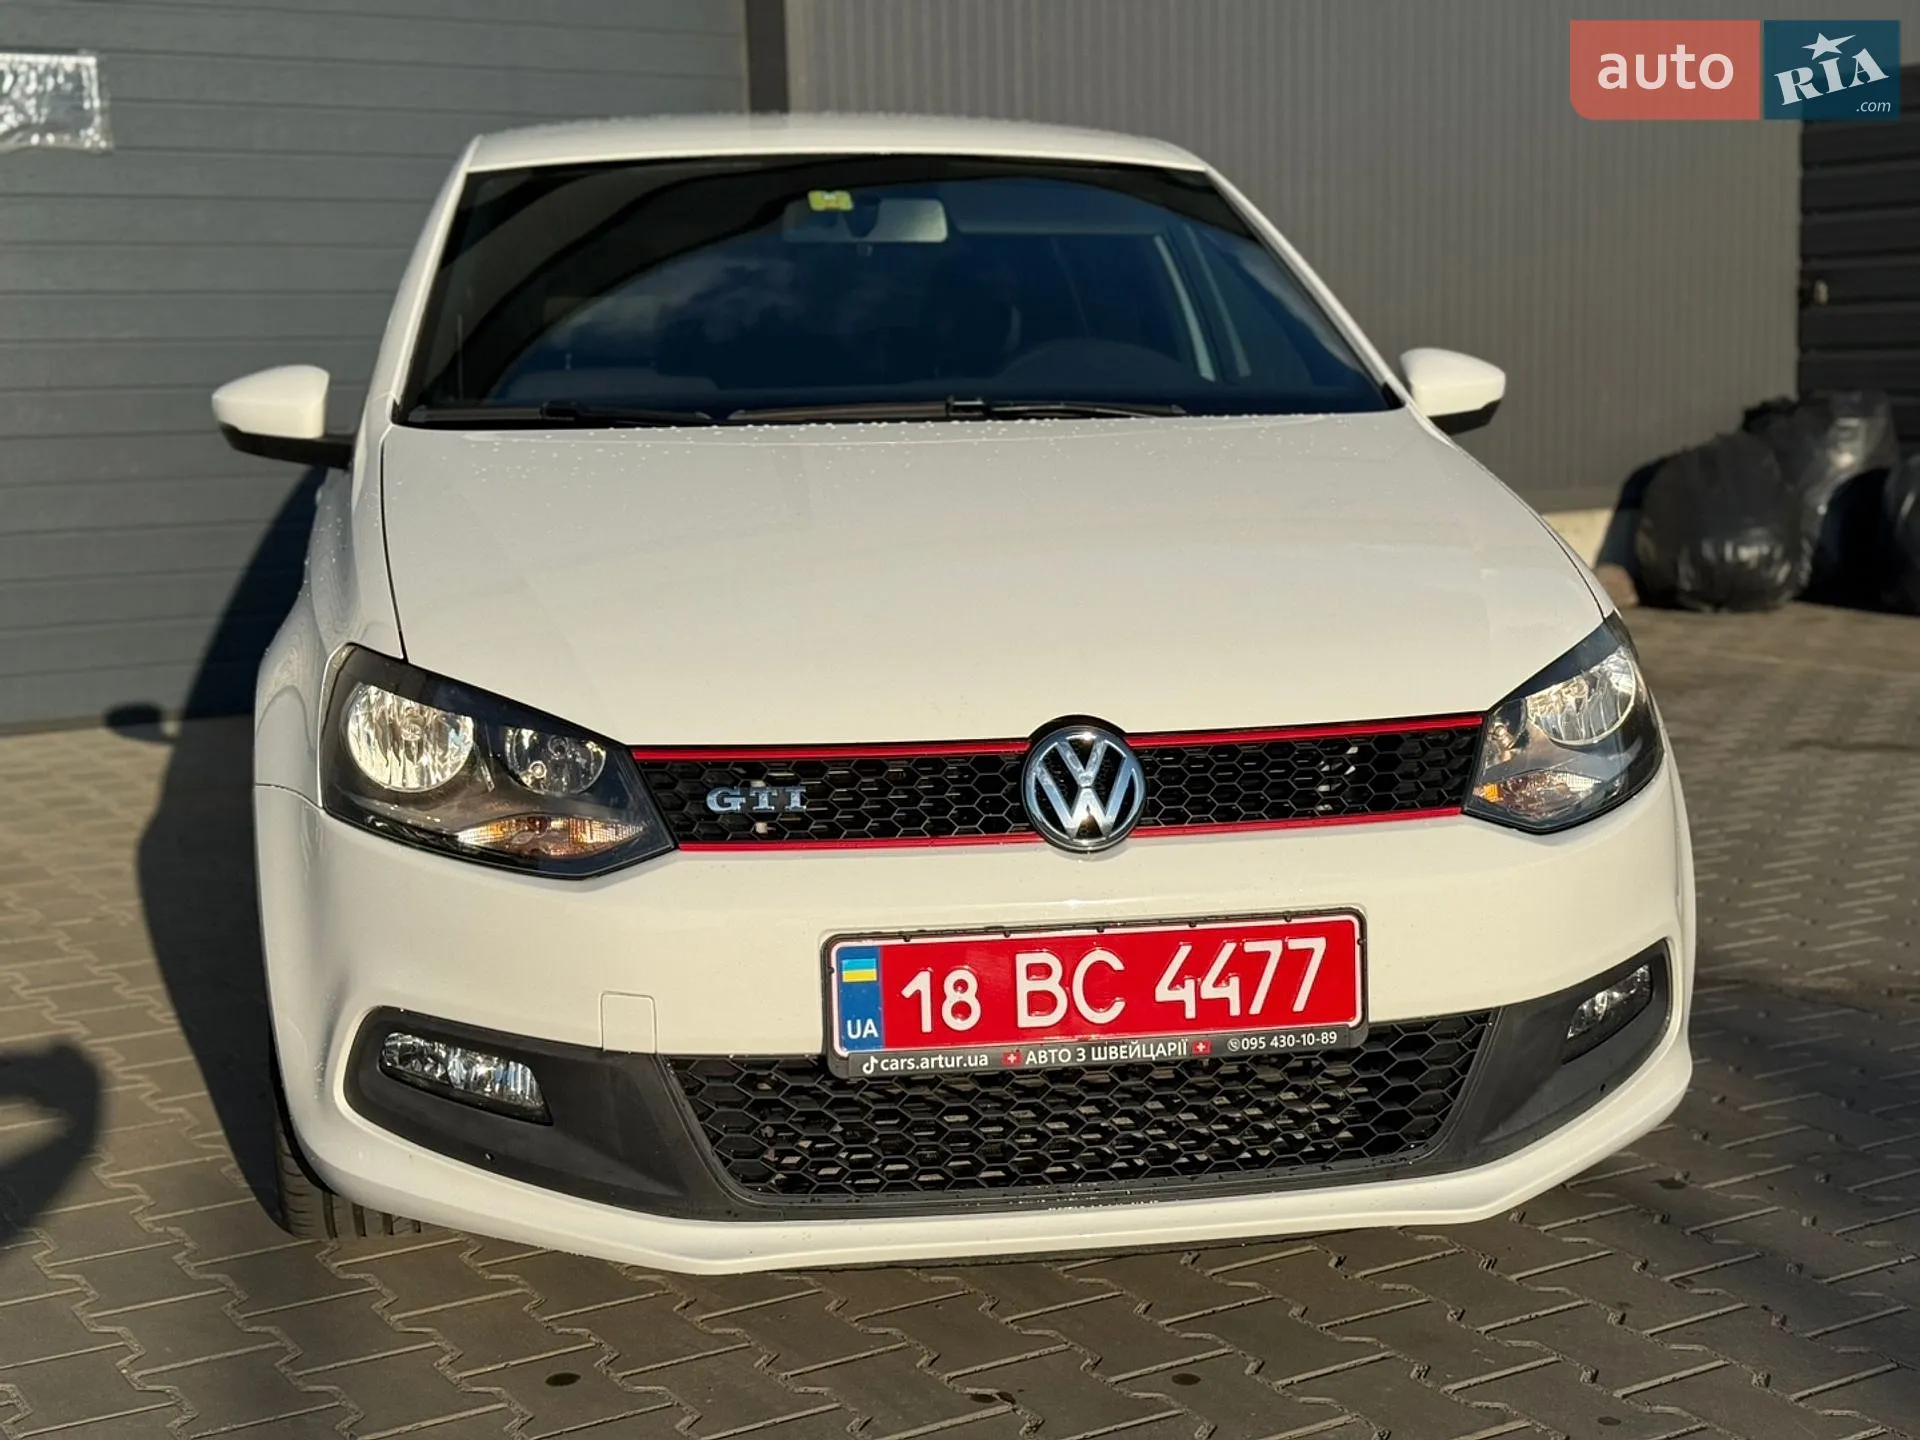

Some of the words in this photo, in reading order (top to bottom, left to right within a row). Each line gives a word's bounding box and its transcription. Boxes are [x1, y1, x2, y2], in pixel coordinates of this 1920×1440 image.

[706, 785, 807, 814] GTI
[901, 968, 981, 1033] 18
[1016, 949, 1125, 1028] BC
[1154, 937, 1327, 1019] 4477
[847, 1018, 879, 1040] UA
[1241, 1036, 1266, 1051] 095
[1270, 1031, 1338, 1048] 430-10-89
[879, 1053, 989, 1073] cars.artur.ua
[1025, 1049, 1072, 1065] АВТО
[1091, 1038, 1188, 1061] ШВЕЙЦАРІЇ
